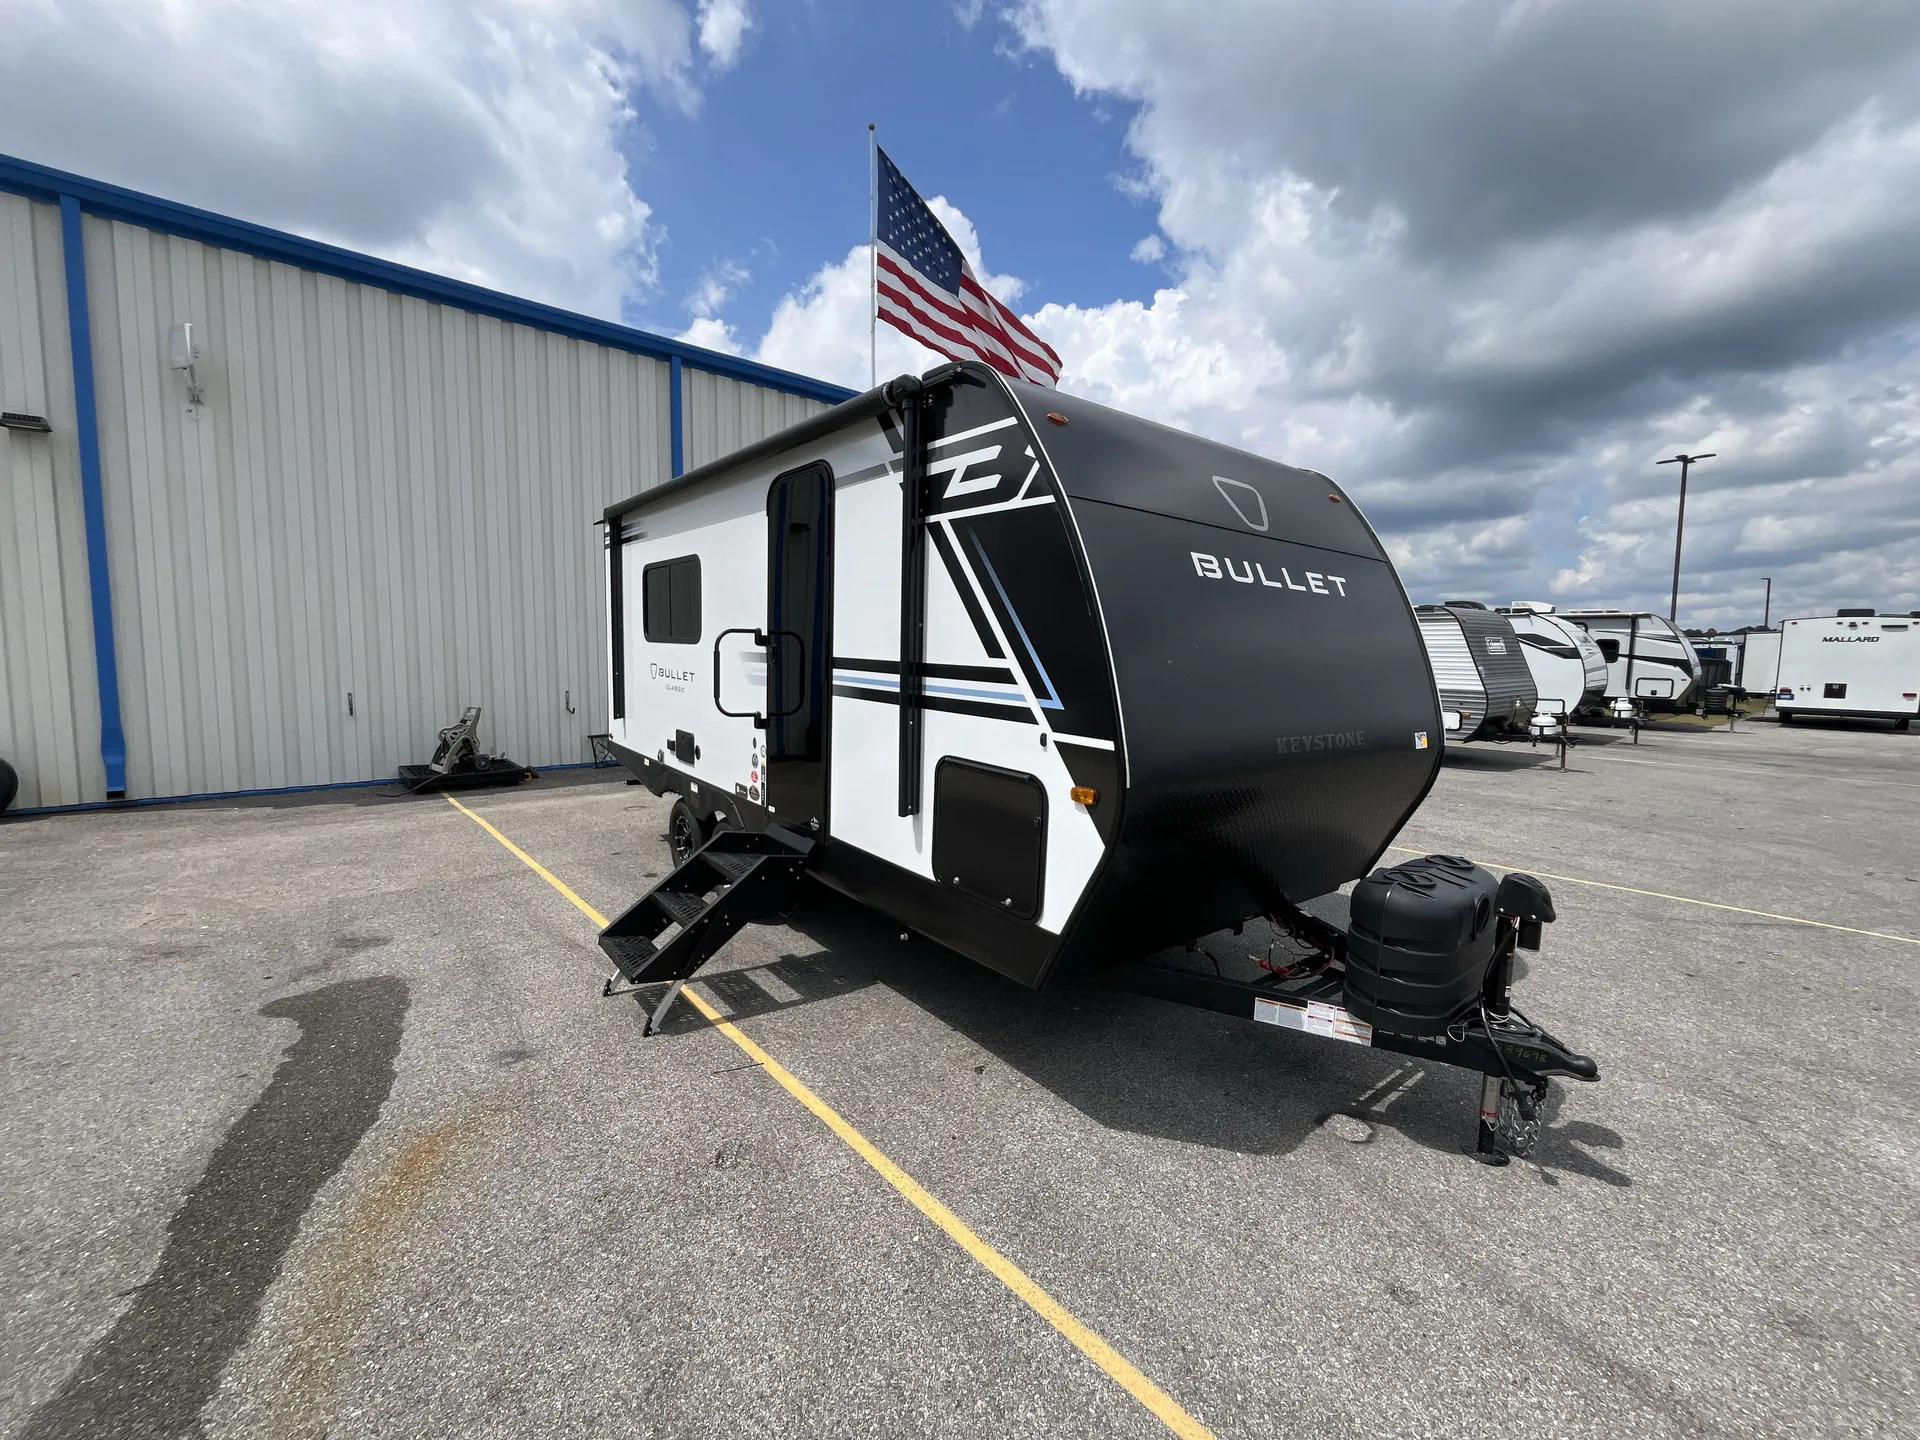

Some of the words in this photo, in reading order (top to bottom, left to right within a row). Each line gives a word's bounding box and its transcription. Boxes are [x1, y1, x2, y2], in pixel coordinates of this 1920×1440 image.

[1190, 551, 1347, 597] BULLET
[658, 667, 696, 682] BULLET
[1275, 730, 1367, 754] KEYSTONE
